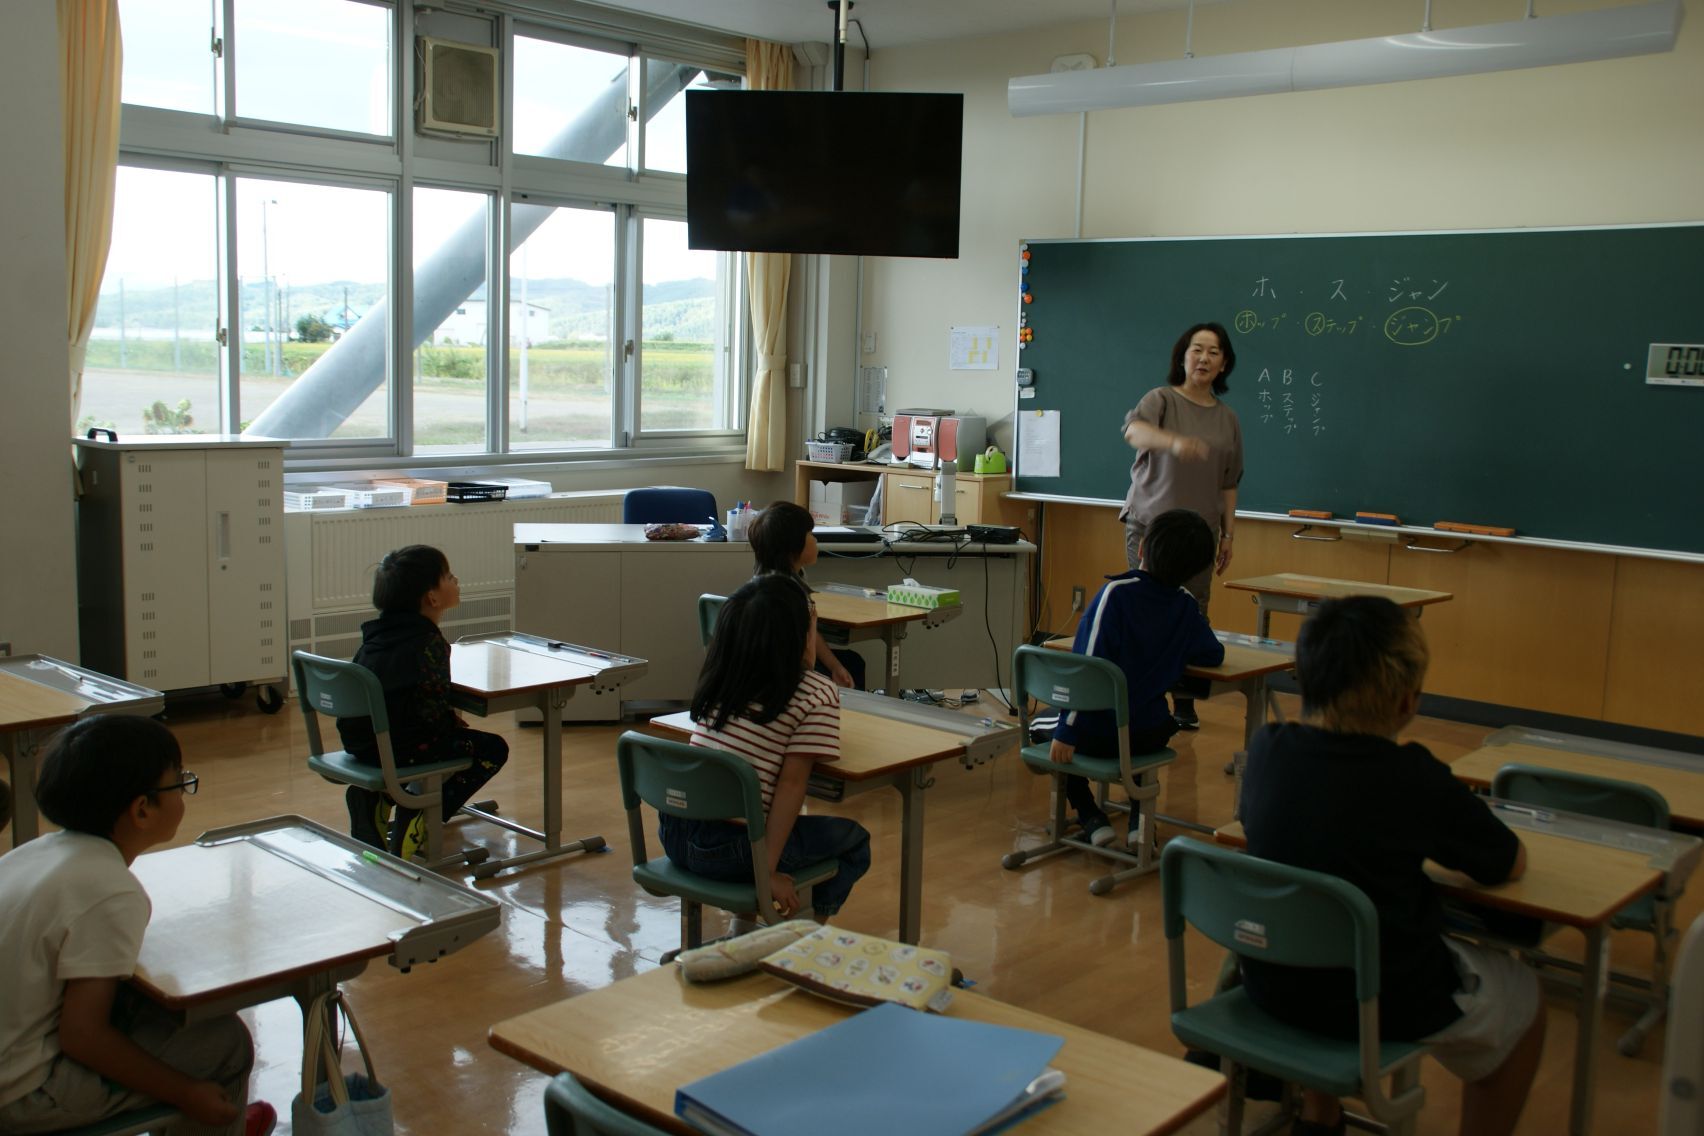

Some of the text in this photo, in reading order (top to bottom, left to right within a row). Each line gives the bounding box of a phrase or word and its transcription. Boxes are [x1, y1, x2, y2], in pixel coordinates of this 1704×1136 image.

[1257, 367, 1323, 387] A B C
